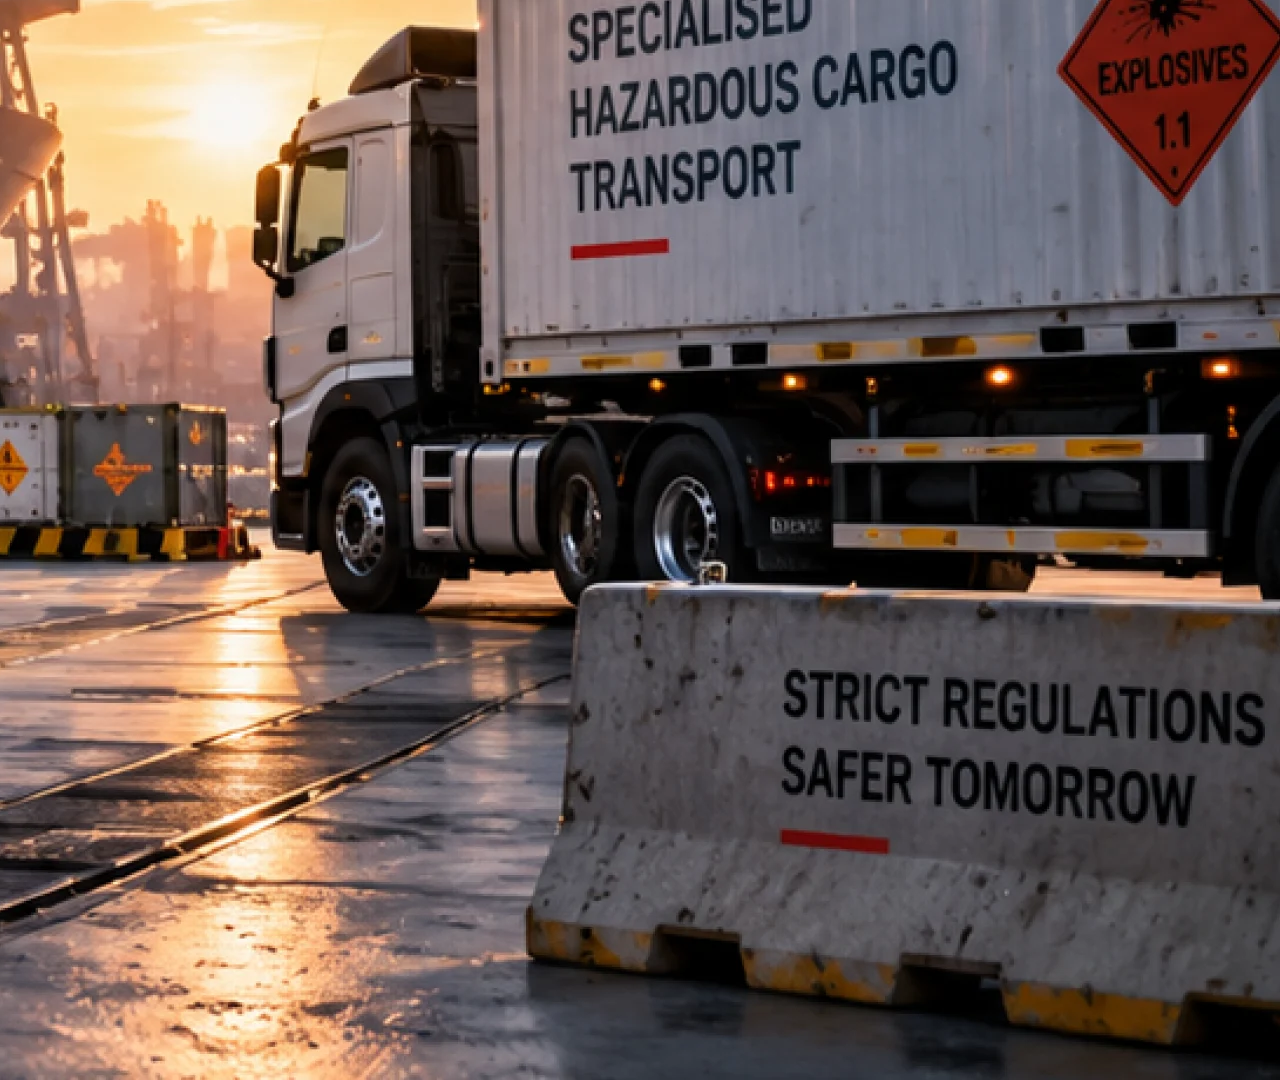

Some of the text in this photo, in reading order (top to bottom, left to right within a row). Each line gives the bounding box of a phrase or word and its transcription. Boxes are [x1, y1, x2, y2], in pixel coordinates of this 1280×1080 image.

[568, 40, 958, 139] HAZARDOUS CARGO
[1097, 43, 1249, 97] EXPLOSIVES
[1154, 110, 1191, 150] 1.1
[569, 140, 802, 214] TRANSPORT
[783, 669, 1266, 747] STRICT REGULATIONS
[781, 745, 1196, 829] SAFER TOMORROW
